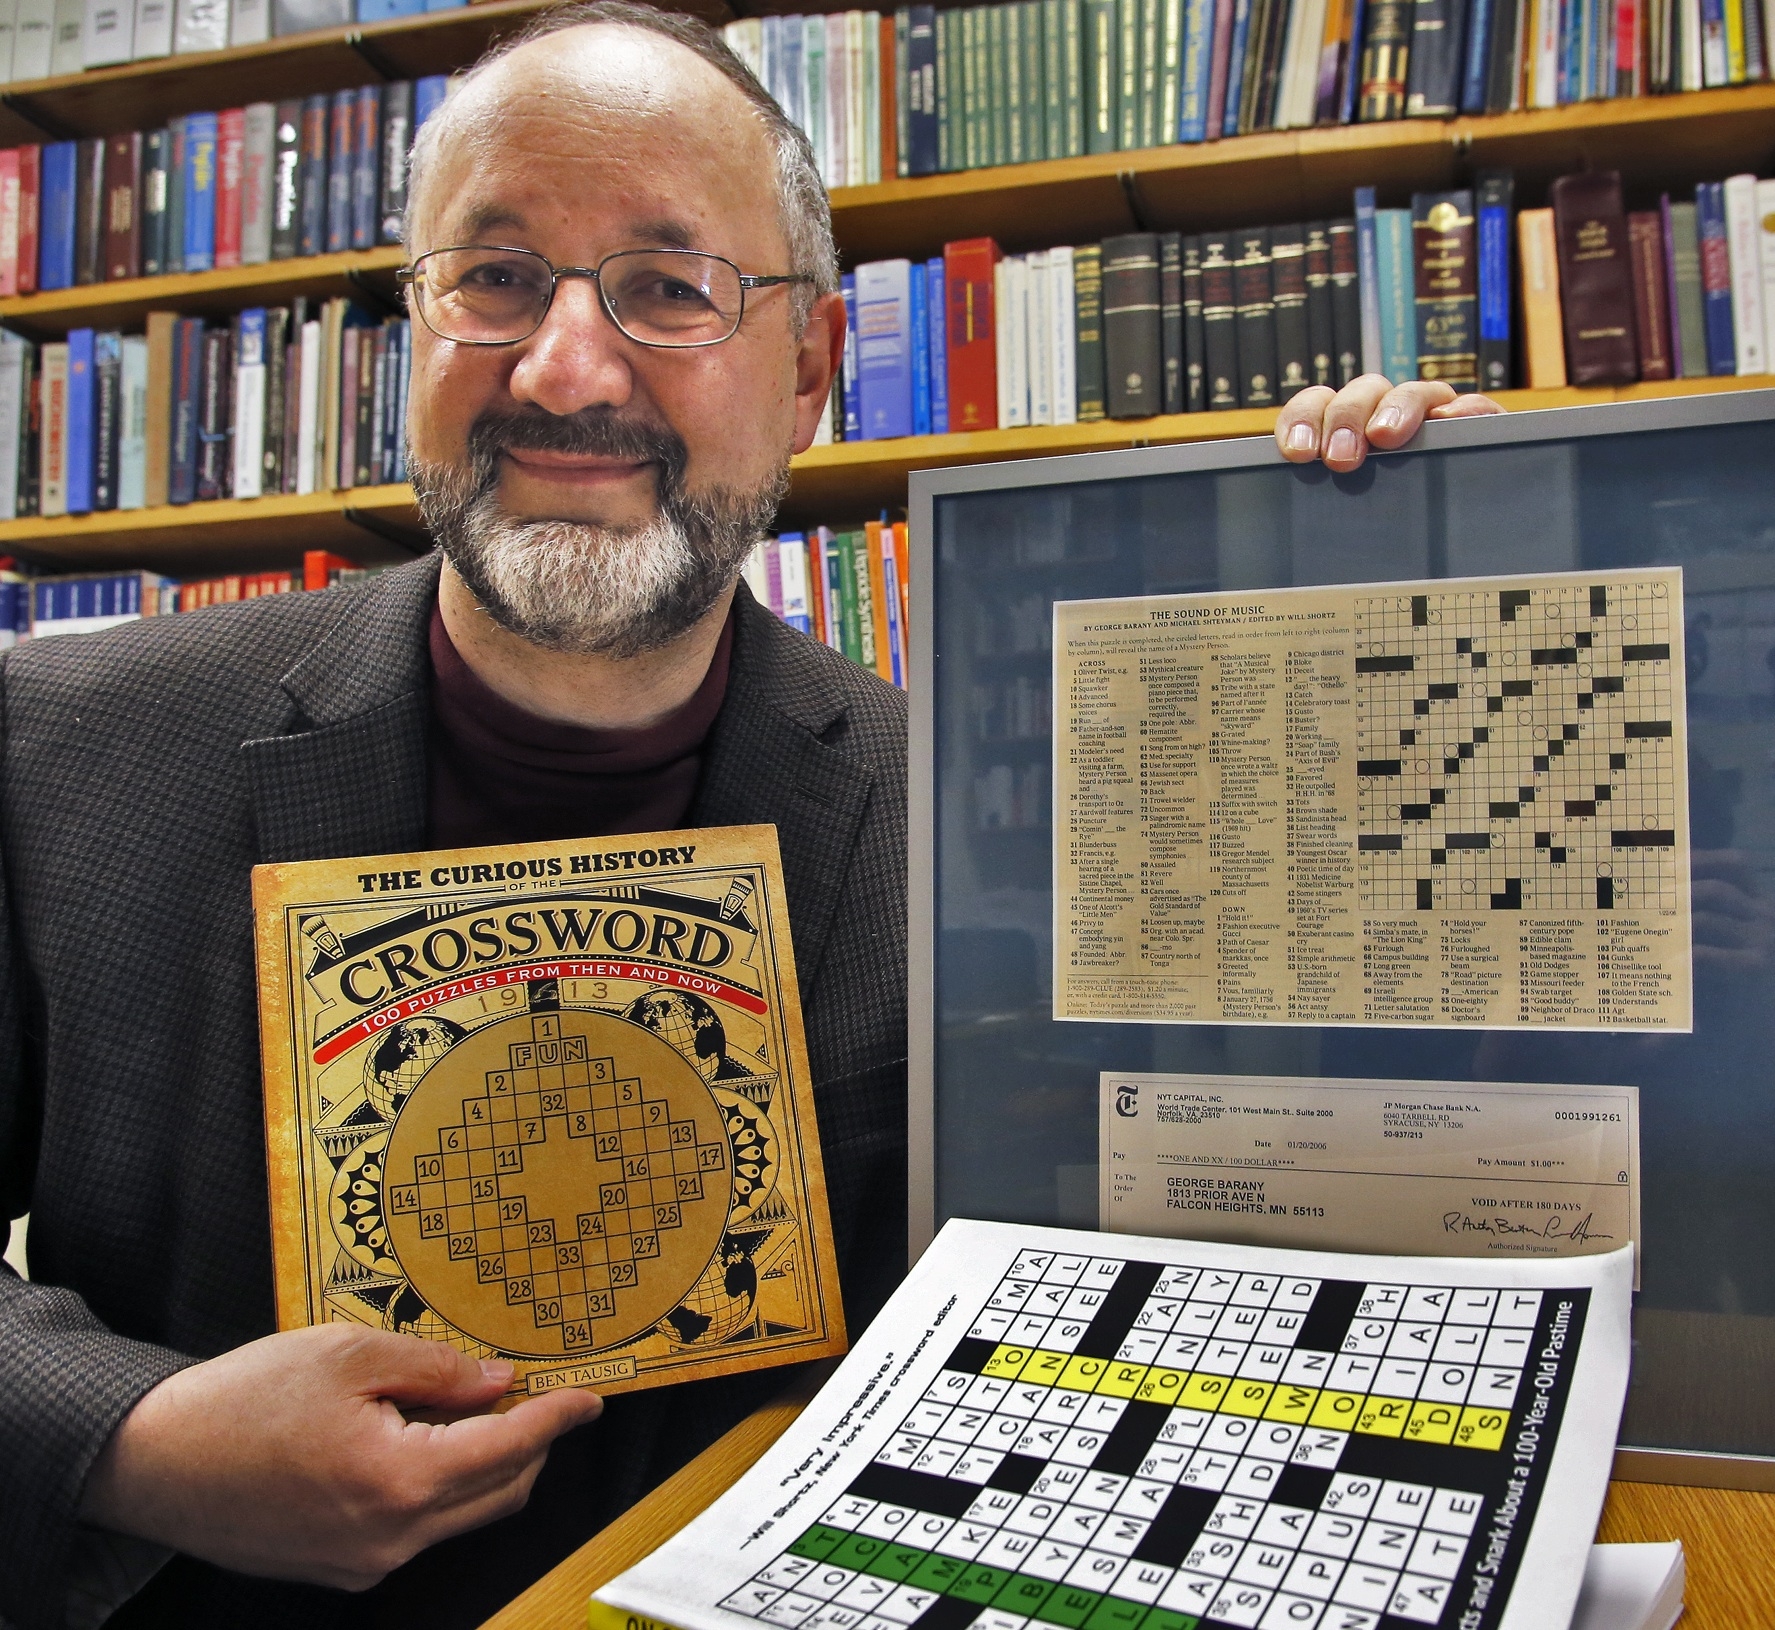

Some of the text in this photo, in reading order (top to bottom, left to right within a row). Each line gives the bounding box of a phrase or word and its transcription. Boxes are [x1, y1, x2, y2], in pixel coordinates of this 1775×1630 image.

[1150, 605, 1265, 620] THE SOUND OF MUSIC
[1124, 622, 1151, 630] BARANY
[1294, 650, 1319, 658] Chicago
[1148, 666, 1176, 674] Mythical
[358, 846, 697, 893] THE CURIOUS HISTORY
[509, 879, 557, 890] OF THE
[1451, 945, 1490, 953] Furloughed
[339, 908, 733, 1007] CROSSWORD
[1402, 954, 1429, 962] building
[361, 964, 722, 1034] 100 PUZZLES FROM THEN AND NOW
[1612, 998, 1658, 1006] Understands
[542, 1022, 551, 1037] 1
[515, 1040, 586, 1066] FUN
[596, 1063, 605, 1079] 3
[543, 1094, 565, 1112] 32
[1174, 1095, 1207, 1103] CAPITAL,
[1394, 1103, 1421, 1112] Morgan
[1383, 1120, 1427, 1128] SYRACUSE,
[1555, 1111, 1621, 1122] 0001991261
[672, 1126, 692, 1143] 13
[1383, 1131, 1423, 1139] 50-937/213
[1255, 1140, 1271, 1148] Date
[1287, 1141, 1327, 1150] 01/20/2006
[701, 1150, 721, 1167] 17
[1113, 1152, 1126, 1160] Pay
[1192, 1156, 1210, 1164] AND
[1477, 1158, 1492, 1167] Pay
[1494, 1159, 1526, 1167] Amount
[1167, 1177, 1264, 1191] GEORGE BARANY
[394, 1189, 415, 1208] 14
[604, 1188, 626, 1206] 20
[1167, 1189, 1265, 1202] 1813 PRIOR AVE N
[1167, 1199, 1324, 1217] FALCON HEIGHTS, MN 55113
[1472, 1198, 1581, 1211] VOID AFTER 180 DAYS
[657, 1208, 678, 1226] 25
[453, 1237, 474, 1254] 22
[1487, 1242, 1558, 1253] Authorized Signature
[613, 1265, 634, 1283] 29
[566, 1326, 588, 1343] 34
[1542, 1301, 1573, 1359] Pastime
[535, 1362, 629, 1388] BEN TAUSIG
[773, 1479, 818, 1518] Shortz,
[815, 1450, 841, 1477] New
[839, 1423, 864, 1448] York
[861, 1389, 892, 1421] Times
[889, 1329, 935, 1387] crossword
[933, 1294, 958, 1327] editor
[1514, 1362, 1558, 1463] 100-Year-Old
[1514, 1466, 1530, 1478] a
[1493, 1479, 1527, 1528] About
[1476, 1527, 1512, 1576] Snark
[1469, 1574, 1495, 1610] and
